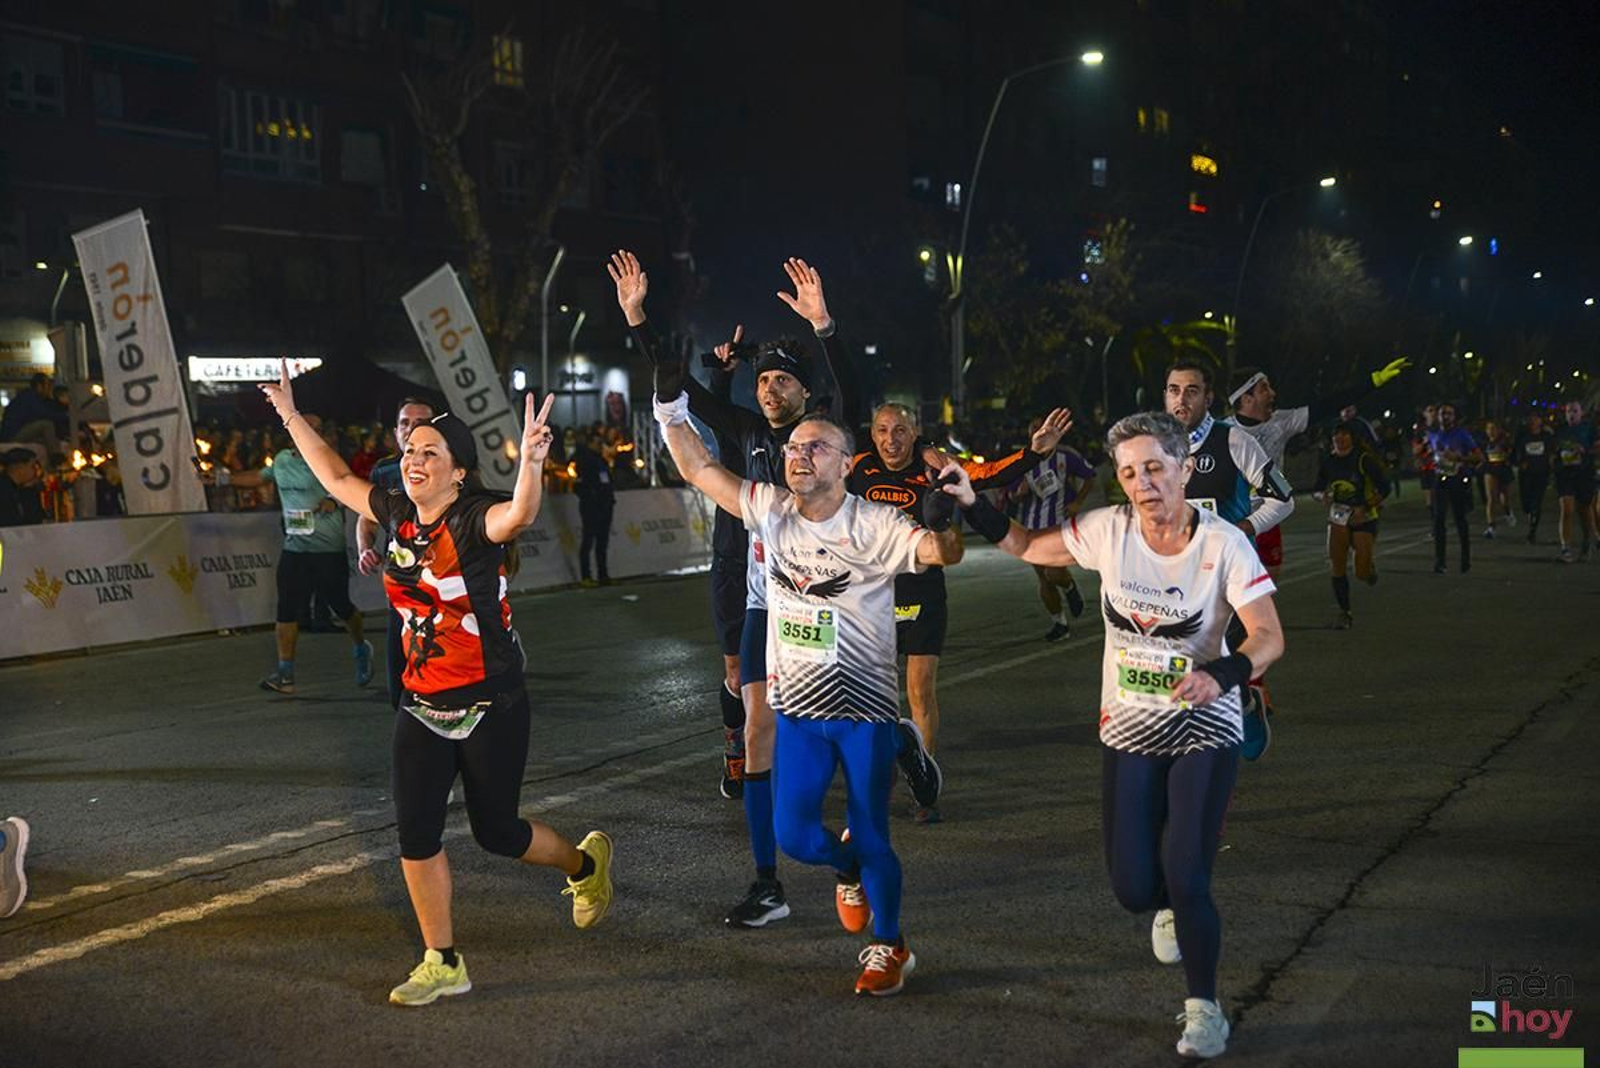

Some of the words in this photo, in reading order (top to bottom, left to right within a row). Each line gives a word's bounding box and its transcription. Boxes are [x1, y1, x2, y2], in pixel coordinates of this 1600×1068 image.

[871, 490, 910, 503] GALBIS
[233, 552, 273, 570] RURAL
[64, 566, 104, 586] CAJA
[105, 562, 155, 583] RURAL
[1119, 579, 1162, 598] valcom
[1110, 593, 1189, 620] VALDEPEÑAS
[782, 621, 822, 642] 3551
[1127, 668, 1176, 690] 3550
